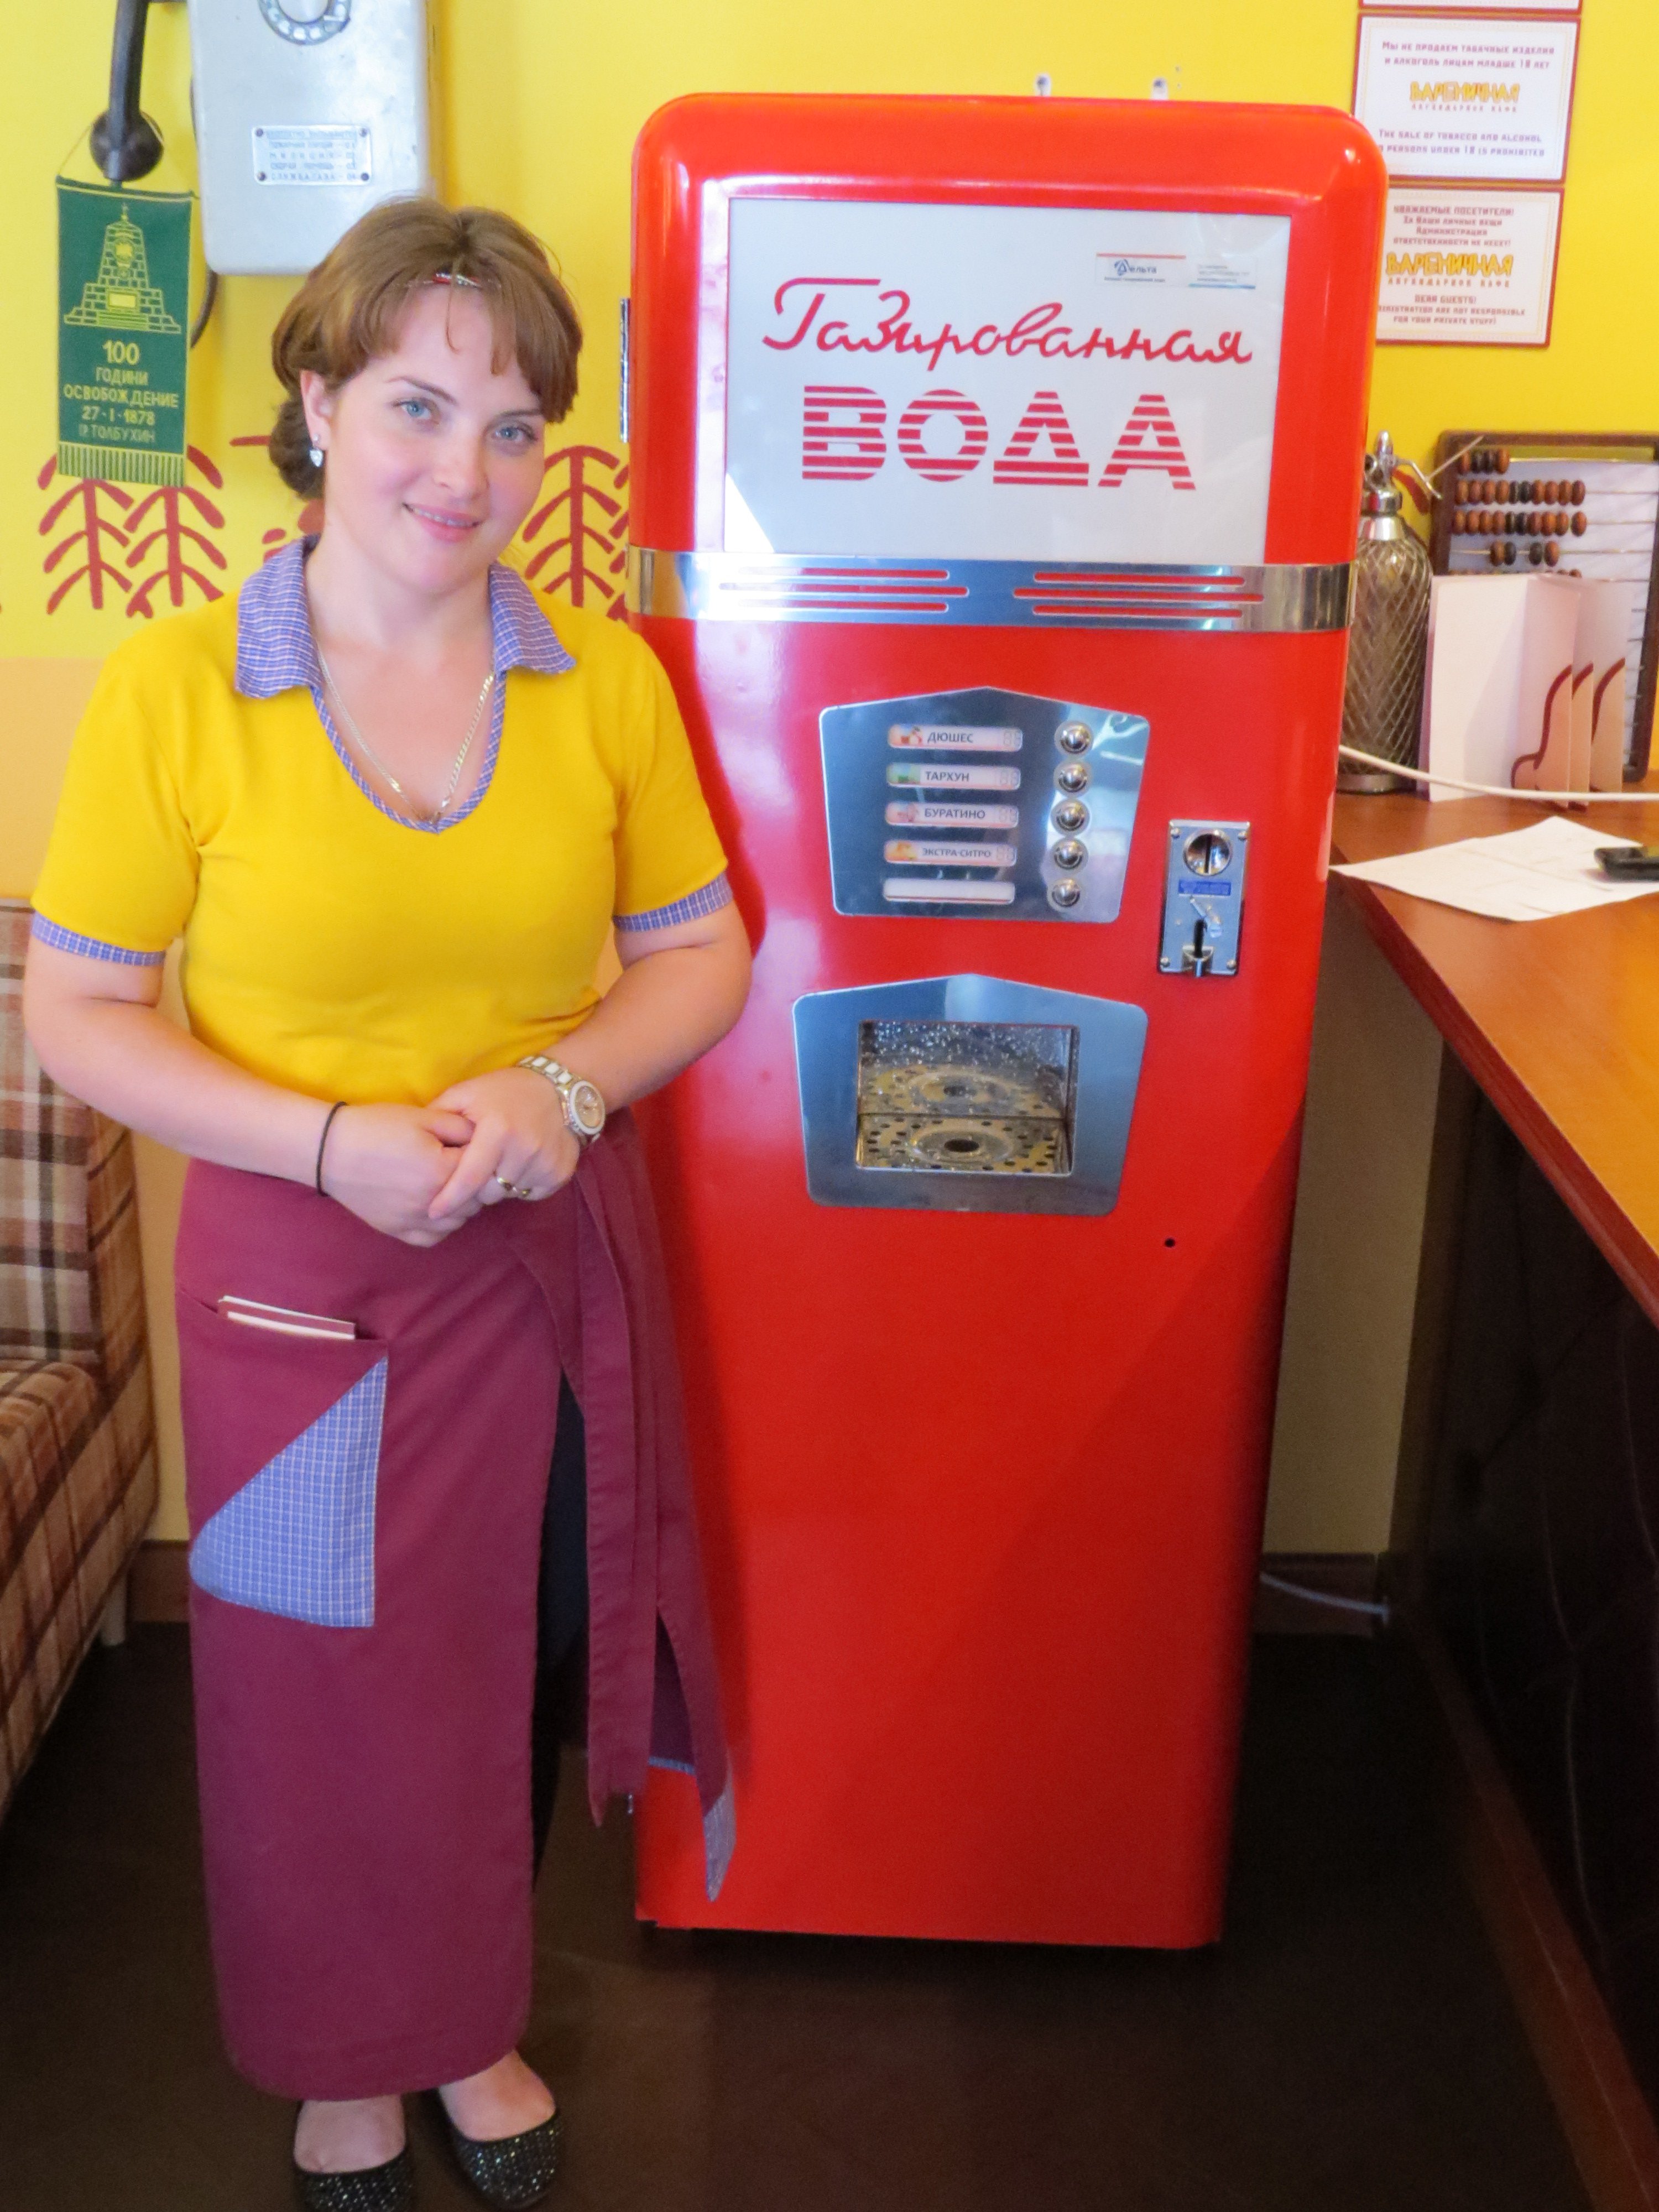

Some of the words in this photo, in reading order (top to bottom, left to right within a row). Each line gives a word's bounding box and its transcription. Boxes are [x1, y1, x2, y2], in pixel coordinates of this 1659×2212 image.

[1415, 43, 1458, 52] ПРОДАЕМ
[1462, 44, 1509, 54] ТАБАЧНЫЕ
[1394, 58, 1439, 66] АЛКОГОЛЬ
[1443, 59, 1474, 67] ЛИЦАМ
[1477, 60, 1515, 68] МЛАДШЕ
[1520, 59, 1531, 69] 18
[1410, 81, 1520, 102] ВАРЕНИЧНАЯ
[1437, 132, 1477, 140] TOBACCO
[1501, 133, 1542, 142] ALCOHOL
[1387, 145, 1427, 154] PERSONS
[1464, 146, 1475, 154] 18
[1490, 148, 1545, 156] PROHIBITED
[1386, 252, 1514, 277] ВАРЕНИЧНАЯ
[761, 276, 1253, 371] Газированная
[102, 339, 140, 366] 100
[96, 367, 149, 386] ГОДИНИ
[64, 384, 179, 409] ОСВОБОЖДЕНИЕ
[802, 385, 1196, 490] ВОДА
[927, 732, 974, 744] ДЮШЕС
[925, 771, 970, 782] ТАРХУН
[924, 808, 986, 819] БУРАТИНО
[922, 847, 991, 858] ЭКСТРА-СИТРО
